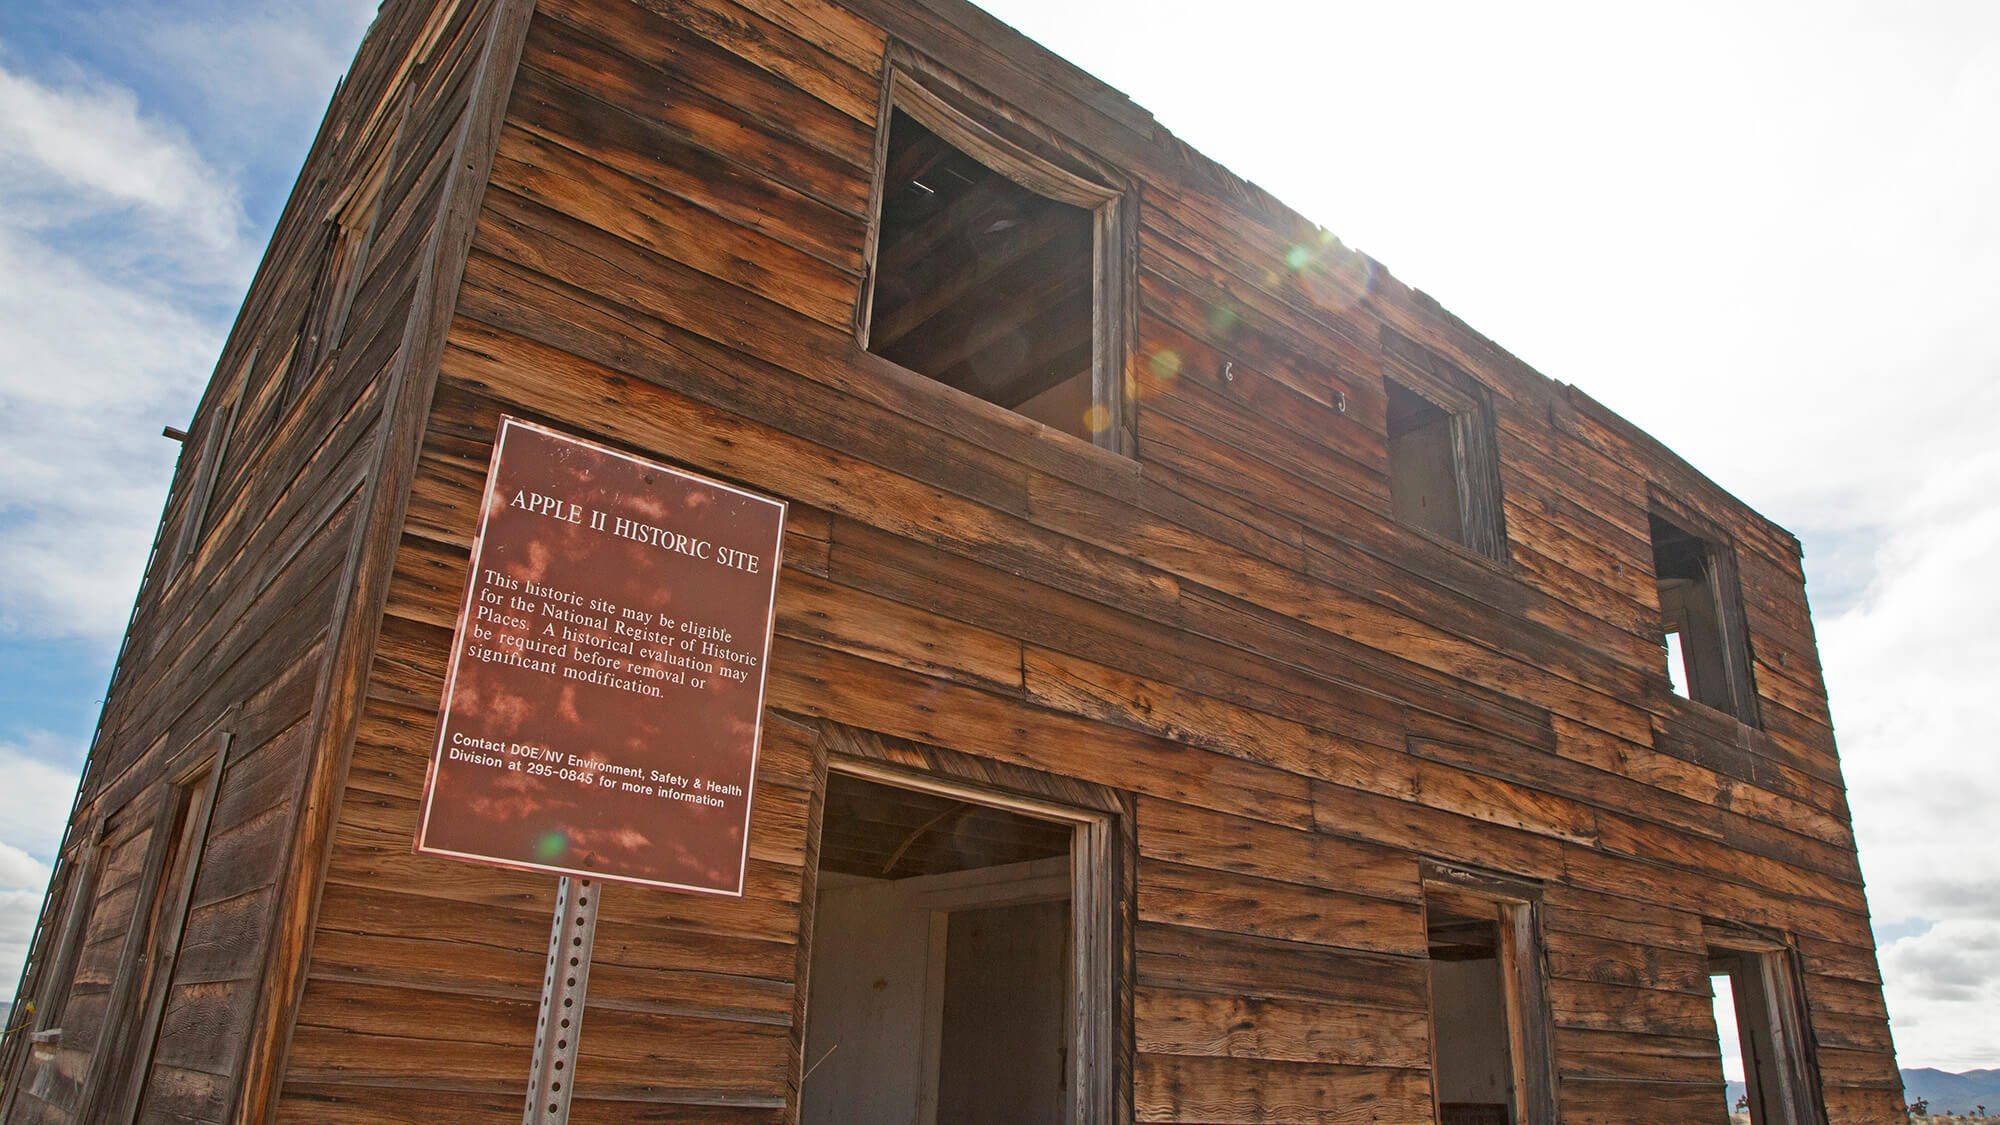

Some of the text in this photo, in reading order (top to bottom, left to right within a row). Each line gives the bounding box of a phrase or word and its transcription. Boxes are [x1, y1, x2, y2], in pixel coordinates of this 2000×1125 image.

[510, 490, 759, 574] APPLE II HISTORIC SITE
[480, 588, 757, 666] for the National Register of Historic
[485, 569, 732, 643] This historic site may be eligible
[468, 644, 664, 698] significant modification.
[473, 624, 706, 689] be required before removal or
[476, 605, 748, 683] Places. A historical evaluation may
[449, 748, 724, 808] Division at 295-0845 for more information
[453, 732, 742, 797] Contact DOE/NV Environment, Safety & Health
